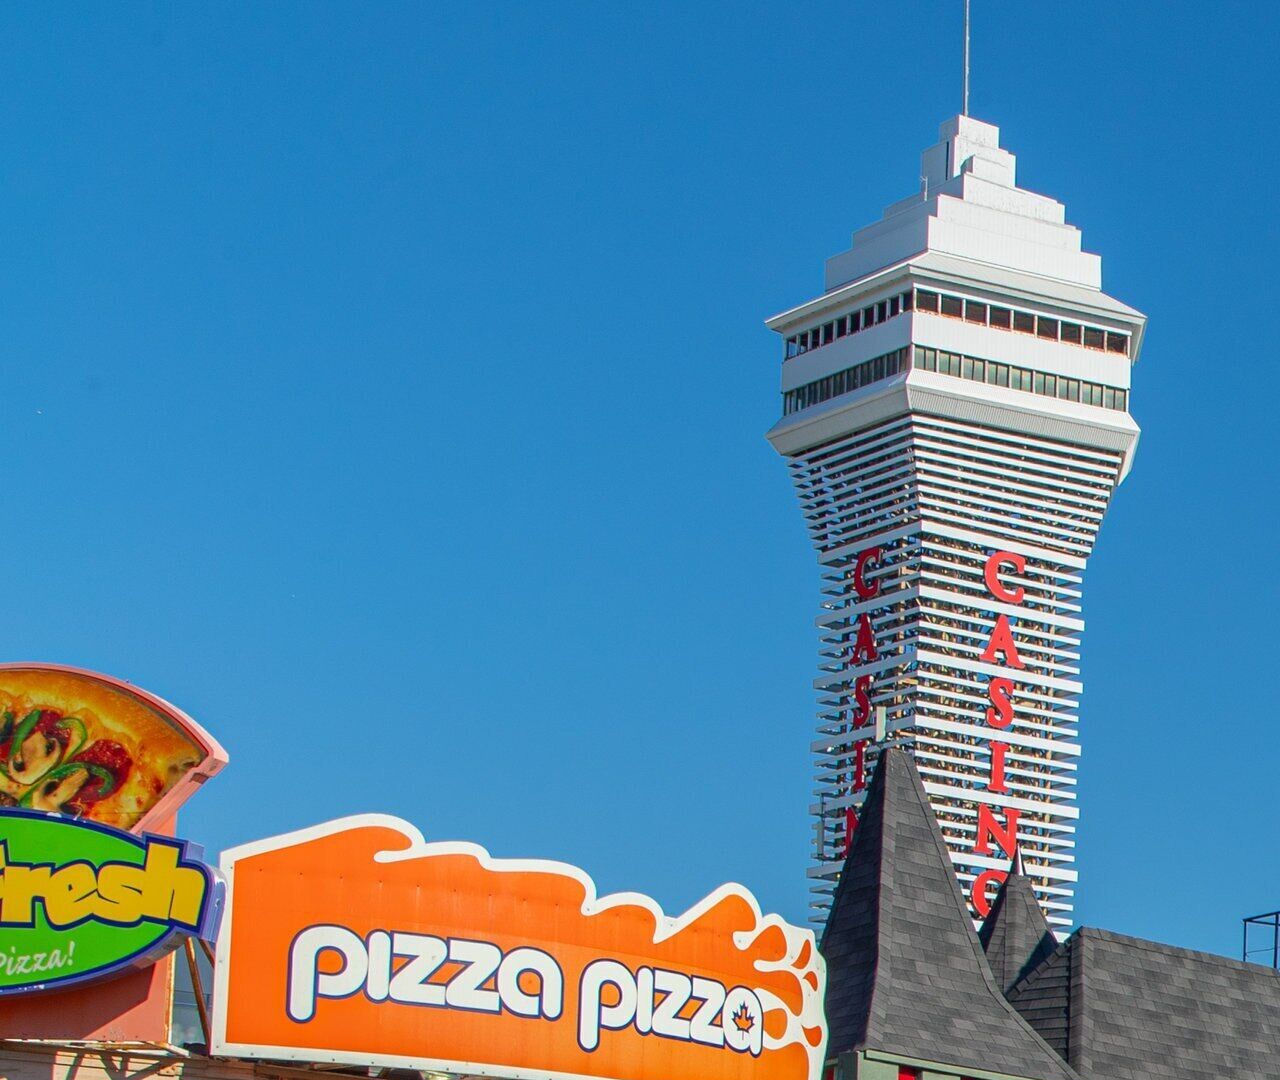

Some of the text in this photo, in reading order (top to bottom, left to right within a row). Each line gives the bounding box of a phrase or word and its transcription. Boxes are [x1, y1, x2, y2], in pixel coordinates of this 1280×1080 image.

[0, 840, 206, 928] resh
[289, 923, 766, 1057] pizza pizza
